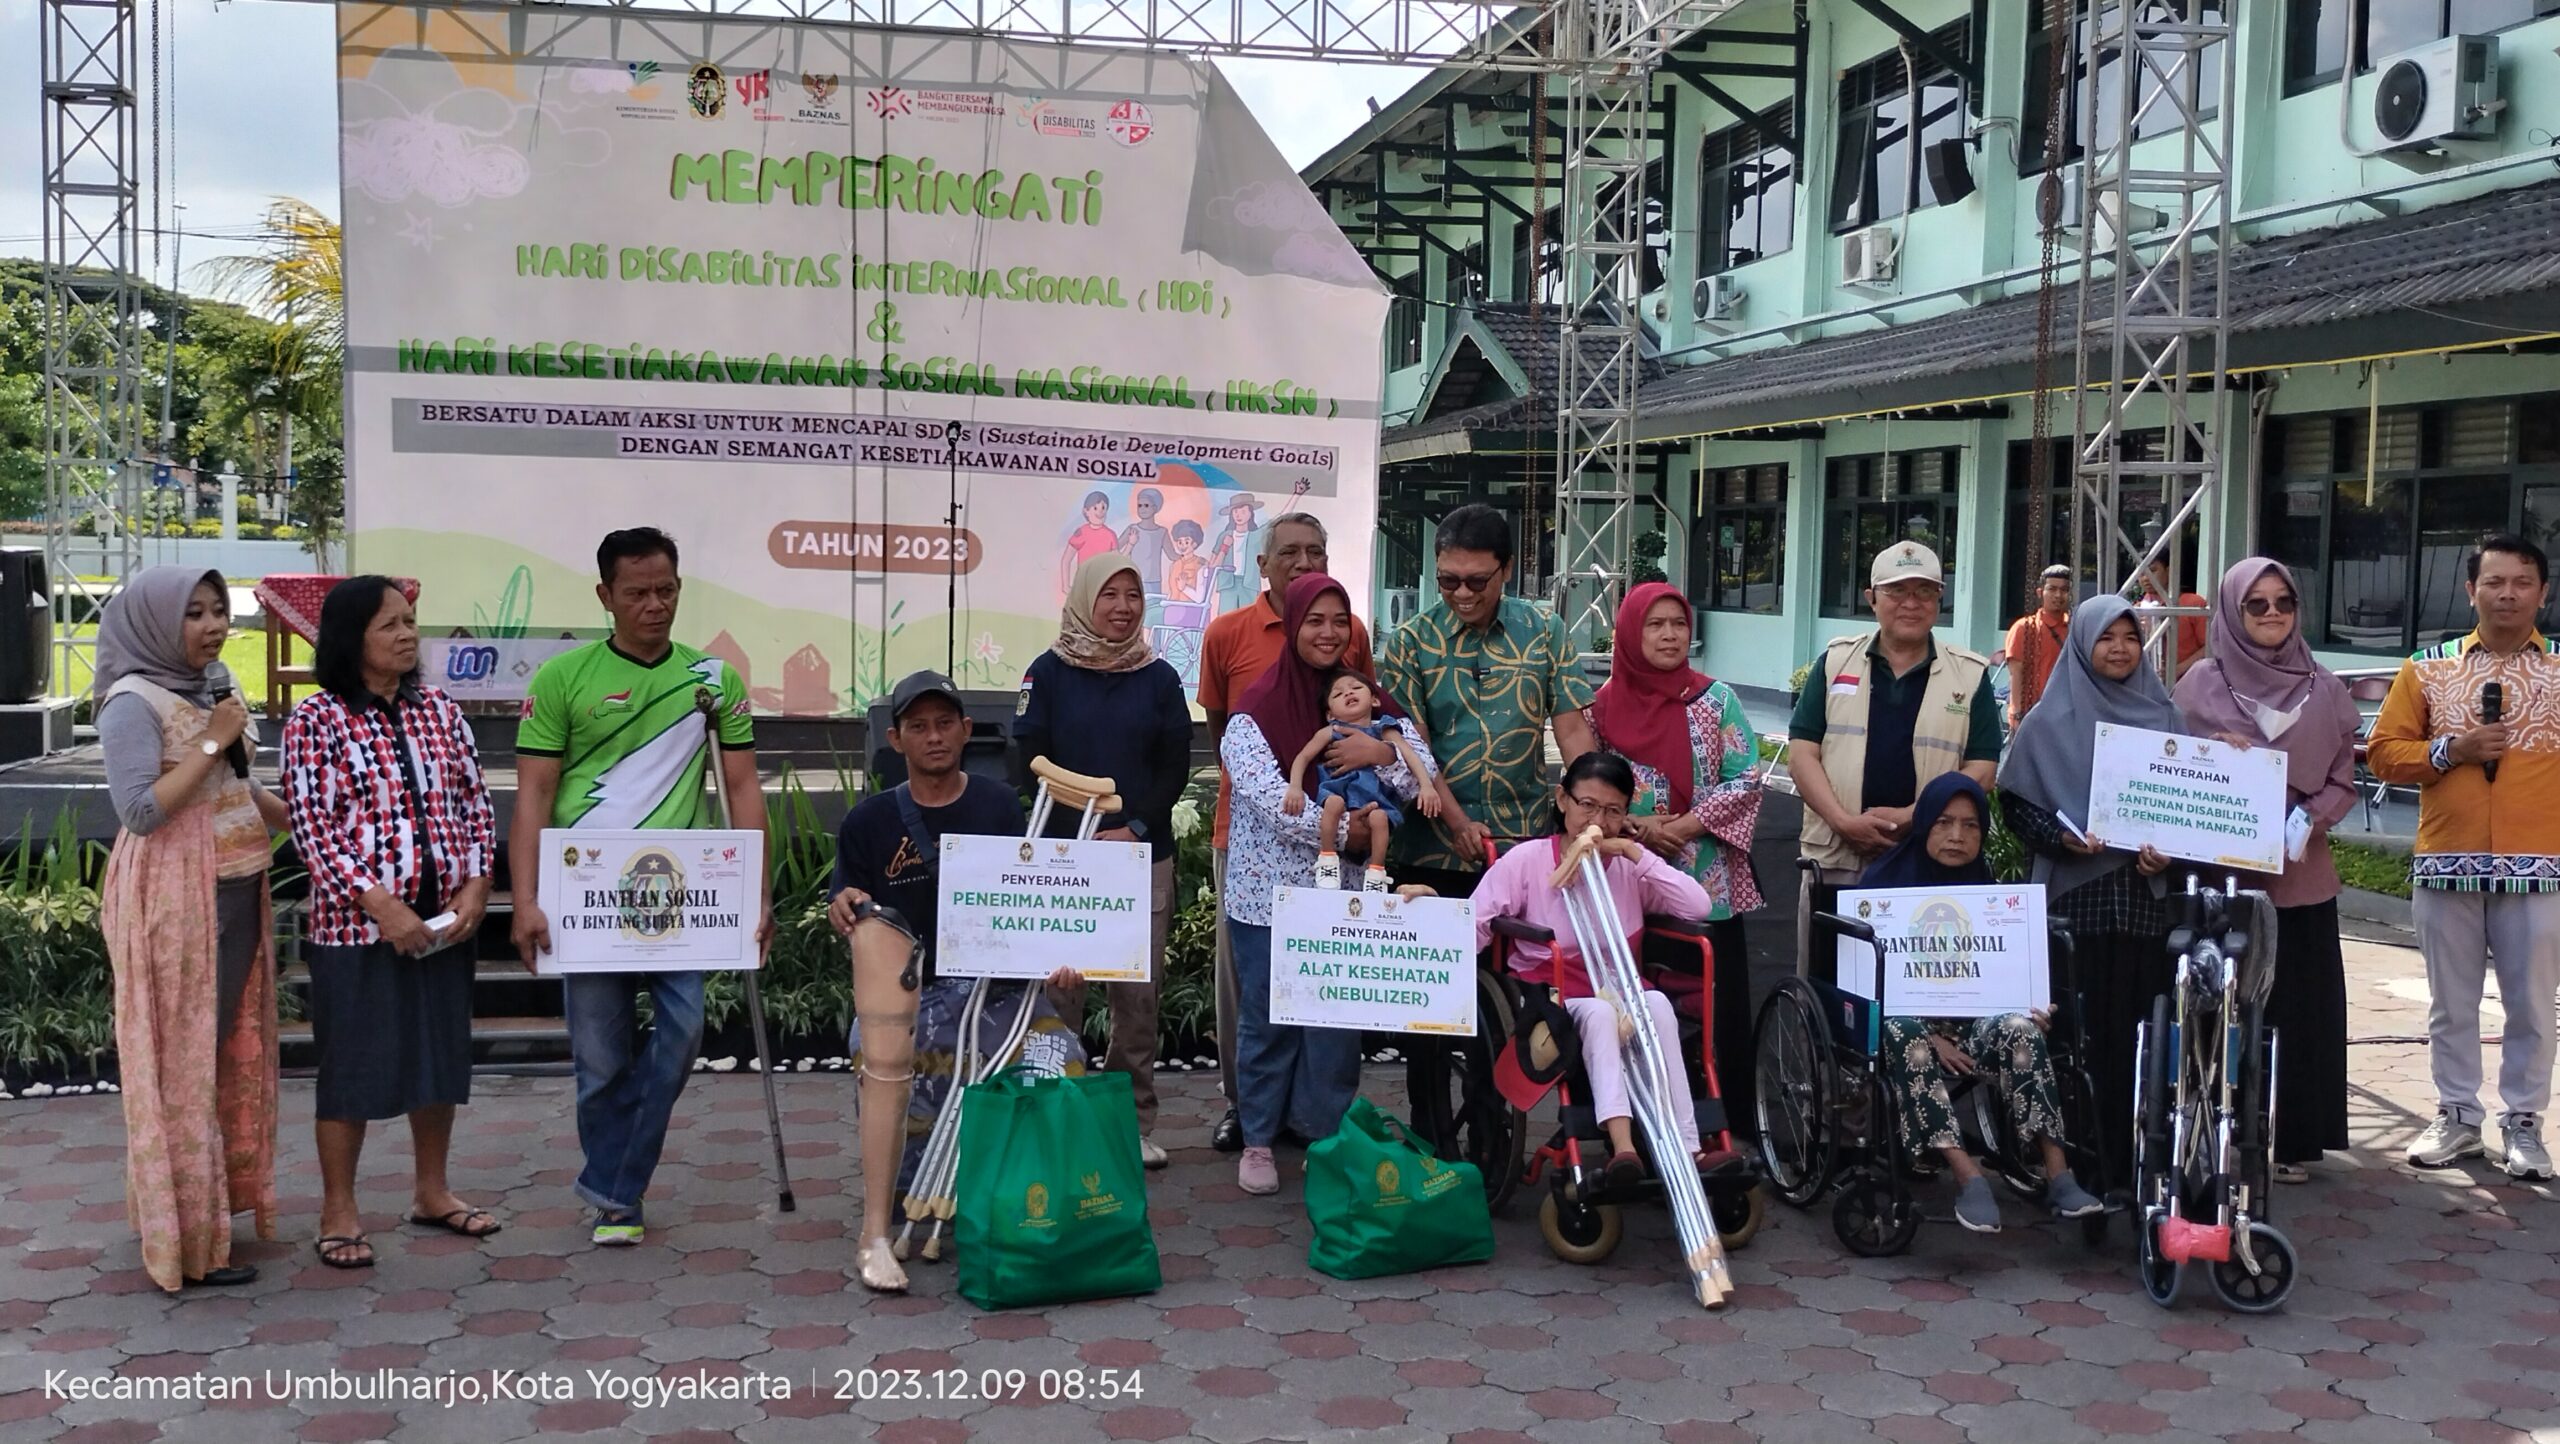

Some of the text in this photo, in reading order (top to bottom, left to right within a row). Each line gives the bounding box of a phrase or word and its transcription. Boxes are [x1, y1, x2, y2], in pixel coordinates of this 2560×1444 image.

[917, 90, 994, 105] BANGKIT BERSAMA
[917, 101, 973, 113] MEMBANGUN
[798, 109, 841, 120] BAZNAS
[1043, 115, 1096, 130] DISABILITAS
[866, 301, 905, 343] &
[1226, 379, 1318, 416] HKSN
[422, 404, 1334, 471] BERSATU DALAM AKSI UNTUK MENCAPAI SDs (Sustainable Development Goals)
[622, 436, 1157, 478] DENGAN SEMANGAT KESETIAKAWANAN SOSIAL
[782, 530, 969, 562] TAHUN 2023
[2149, 763, 2230, 784] PENYERAHAN
[2129, 780, 2248, 807] PENERIMA MANFAAT
[2117, 793, 2259, 824] SANTUNAN DISABILITAS
[2117, 808, 2258, 840] (2 PENERIMA MANFAAT)
[1001, 873, 1090, 888] PENYERAHAN
[584, 889, 720, 908] BANTUAN SOSIAL
[953, 892, 1136, 912] PENERIMA MANFAAT
[562, 915, 579, 930] CV
[583, 914, 640, 930] BINTANG
[690, 913, 739, 928] MADANI
[992, 916, 1097, 933] KAKI PALSU
[1331, 926, 1418, 942] PENYERAHAN
[1881, 935, 2007, 953] BANTUAN SOSIAL
[1286, 938, 1463, 963] PENERIMA MANFAAT
[1299, 962, 1450, 984] ALAT KESEHATAN
[1904, 961, 1982, 978] ANTASENA
[1319, 985, 1430, 1008] (NEBULIZER)
